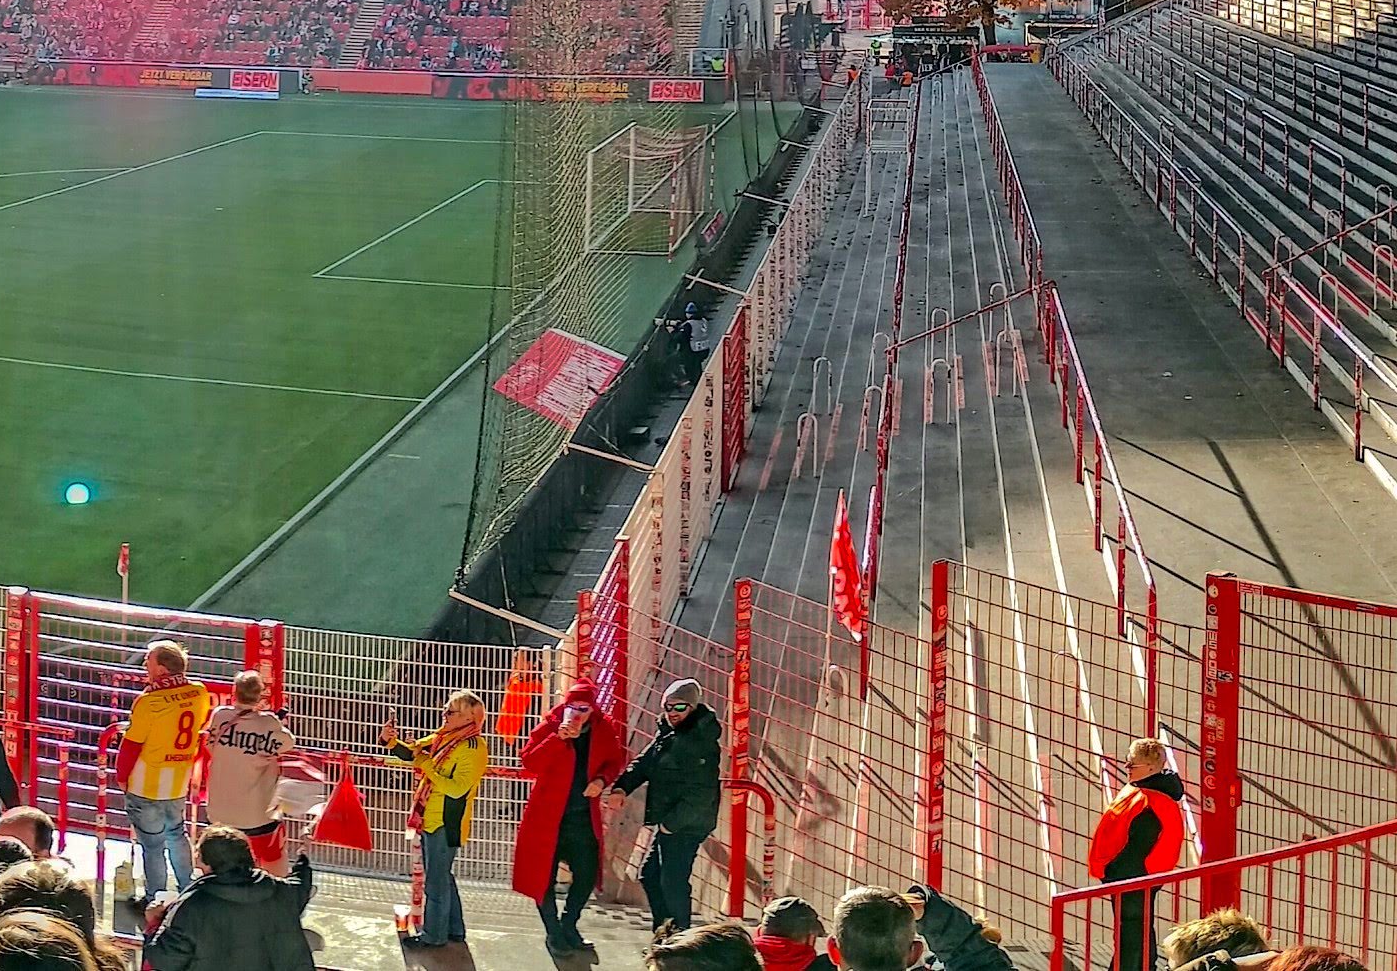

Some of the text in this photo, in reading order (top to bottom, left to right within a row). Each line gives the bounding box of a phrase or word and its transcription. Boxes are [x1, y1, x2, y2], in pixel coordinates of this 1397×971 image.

[140, 69, 213, 81] JETZT VERFÜGBAR
[232, 72, 278, 89] EISERN
[651, 82, 703, 99] EISERN
[171, 693, 181, 702] FC
[174, 710, 196, 750] 8
